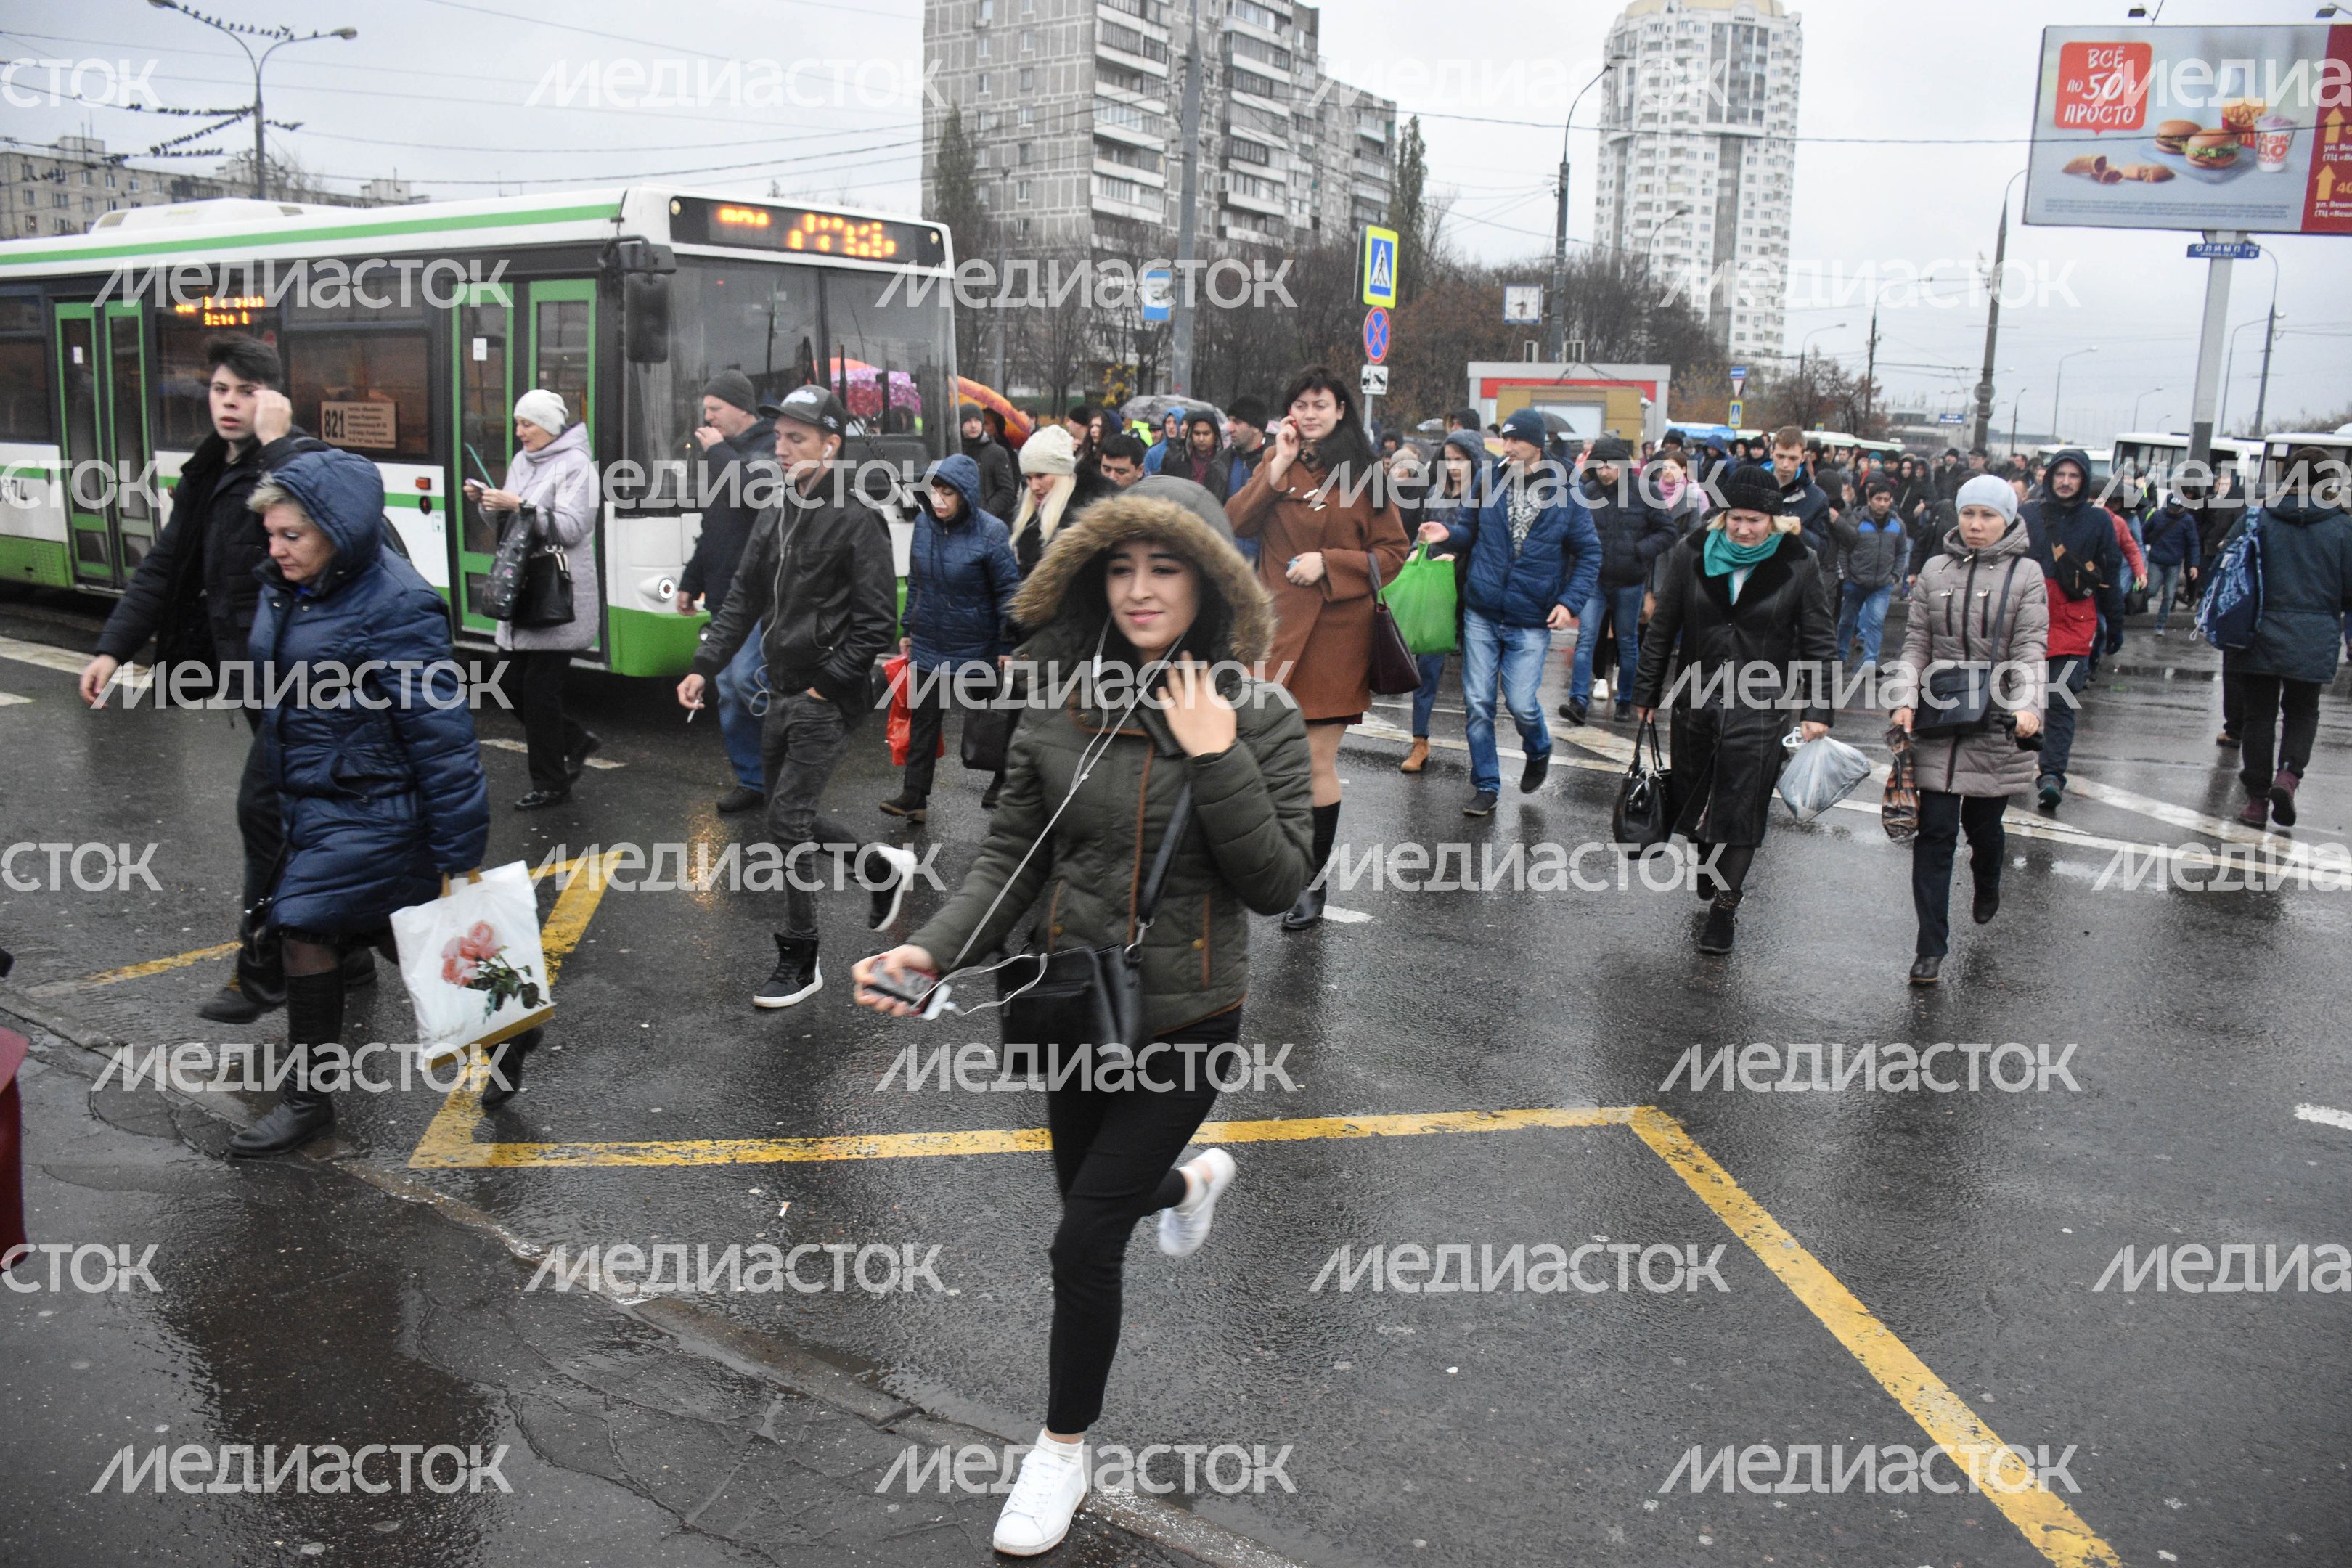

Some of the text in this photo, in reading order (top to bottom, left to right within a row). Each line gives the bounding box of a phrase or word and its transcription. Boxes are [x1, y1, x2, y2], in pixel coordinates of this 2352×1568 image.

[2088, 45, 2126, 69] ВСЁ
[2082, 72, 2125, 100] 50
[2064, 102, 2136, 125] ПРОСТО
[324, 409, 345, 438] 821
